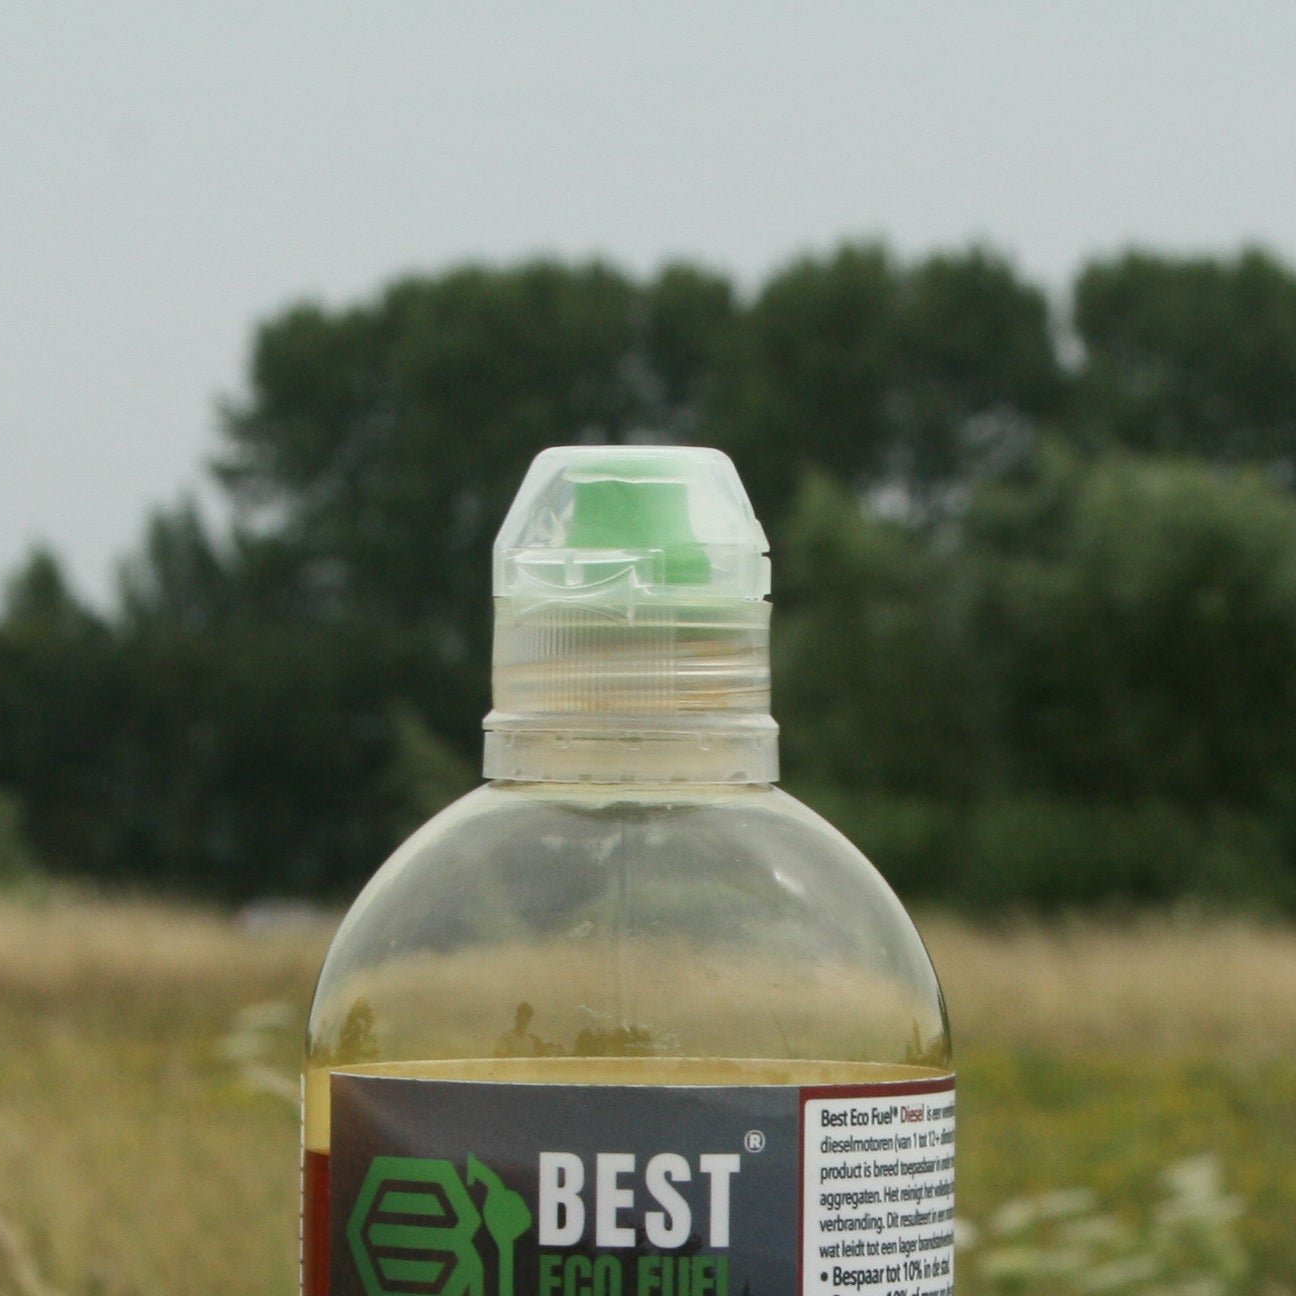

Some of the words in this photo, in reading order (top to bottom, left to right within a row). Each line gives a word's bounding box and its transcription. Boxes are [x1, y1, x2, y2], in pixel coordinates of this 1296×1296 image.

[821, 1110, 848, 1127] Best
[850, 1109, 869, 1125] Eco
[900, 1104, 924, 1123] Diesel
[821, 1134, 893, 1153] dieselmotoren
[821, 1162, 862, 1184] product
[864, 1162, 871, 1178] is
[874, 1159, 898, 1177] breed
[538, 1152, 741, 1249] BEST
[820, 1190, 882, 1210] aggregaten.
[884, 1186, 899, 1202] Het
[820, 1213, 885, 1234] verbranding.
[887, 1212, 899, 1228] Dit
[819, 1241, 840, 1258] wat
[842, 1239, 865, 1257] leidt
[867, 1240, 880, 1256] tot
[882, 1241, 897, 1255] een
[833, 1266, 884, 1291] Bespaar
[886, 1264, 901, 1282] tot
[904, 1260, 922, 1279] 10%
